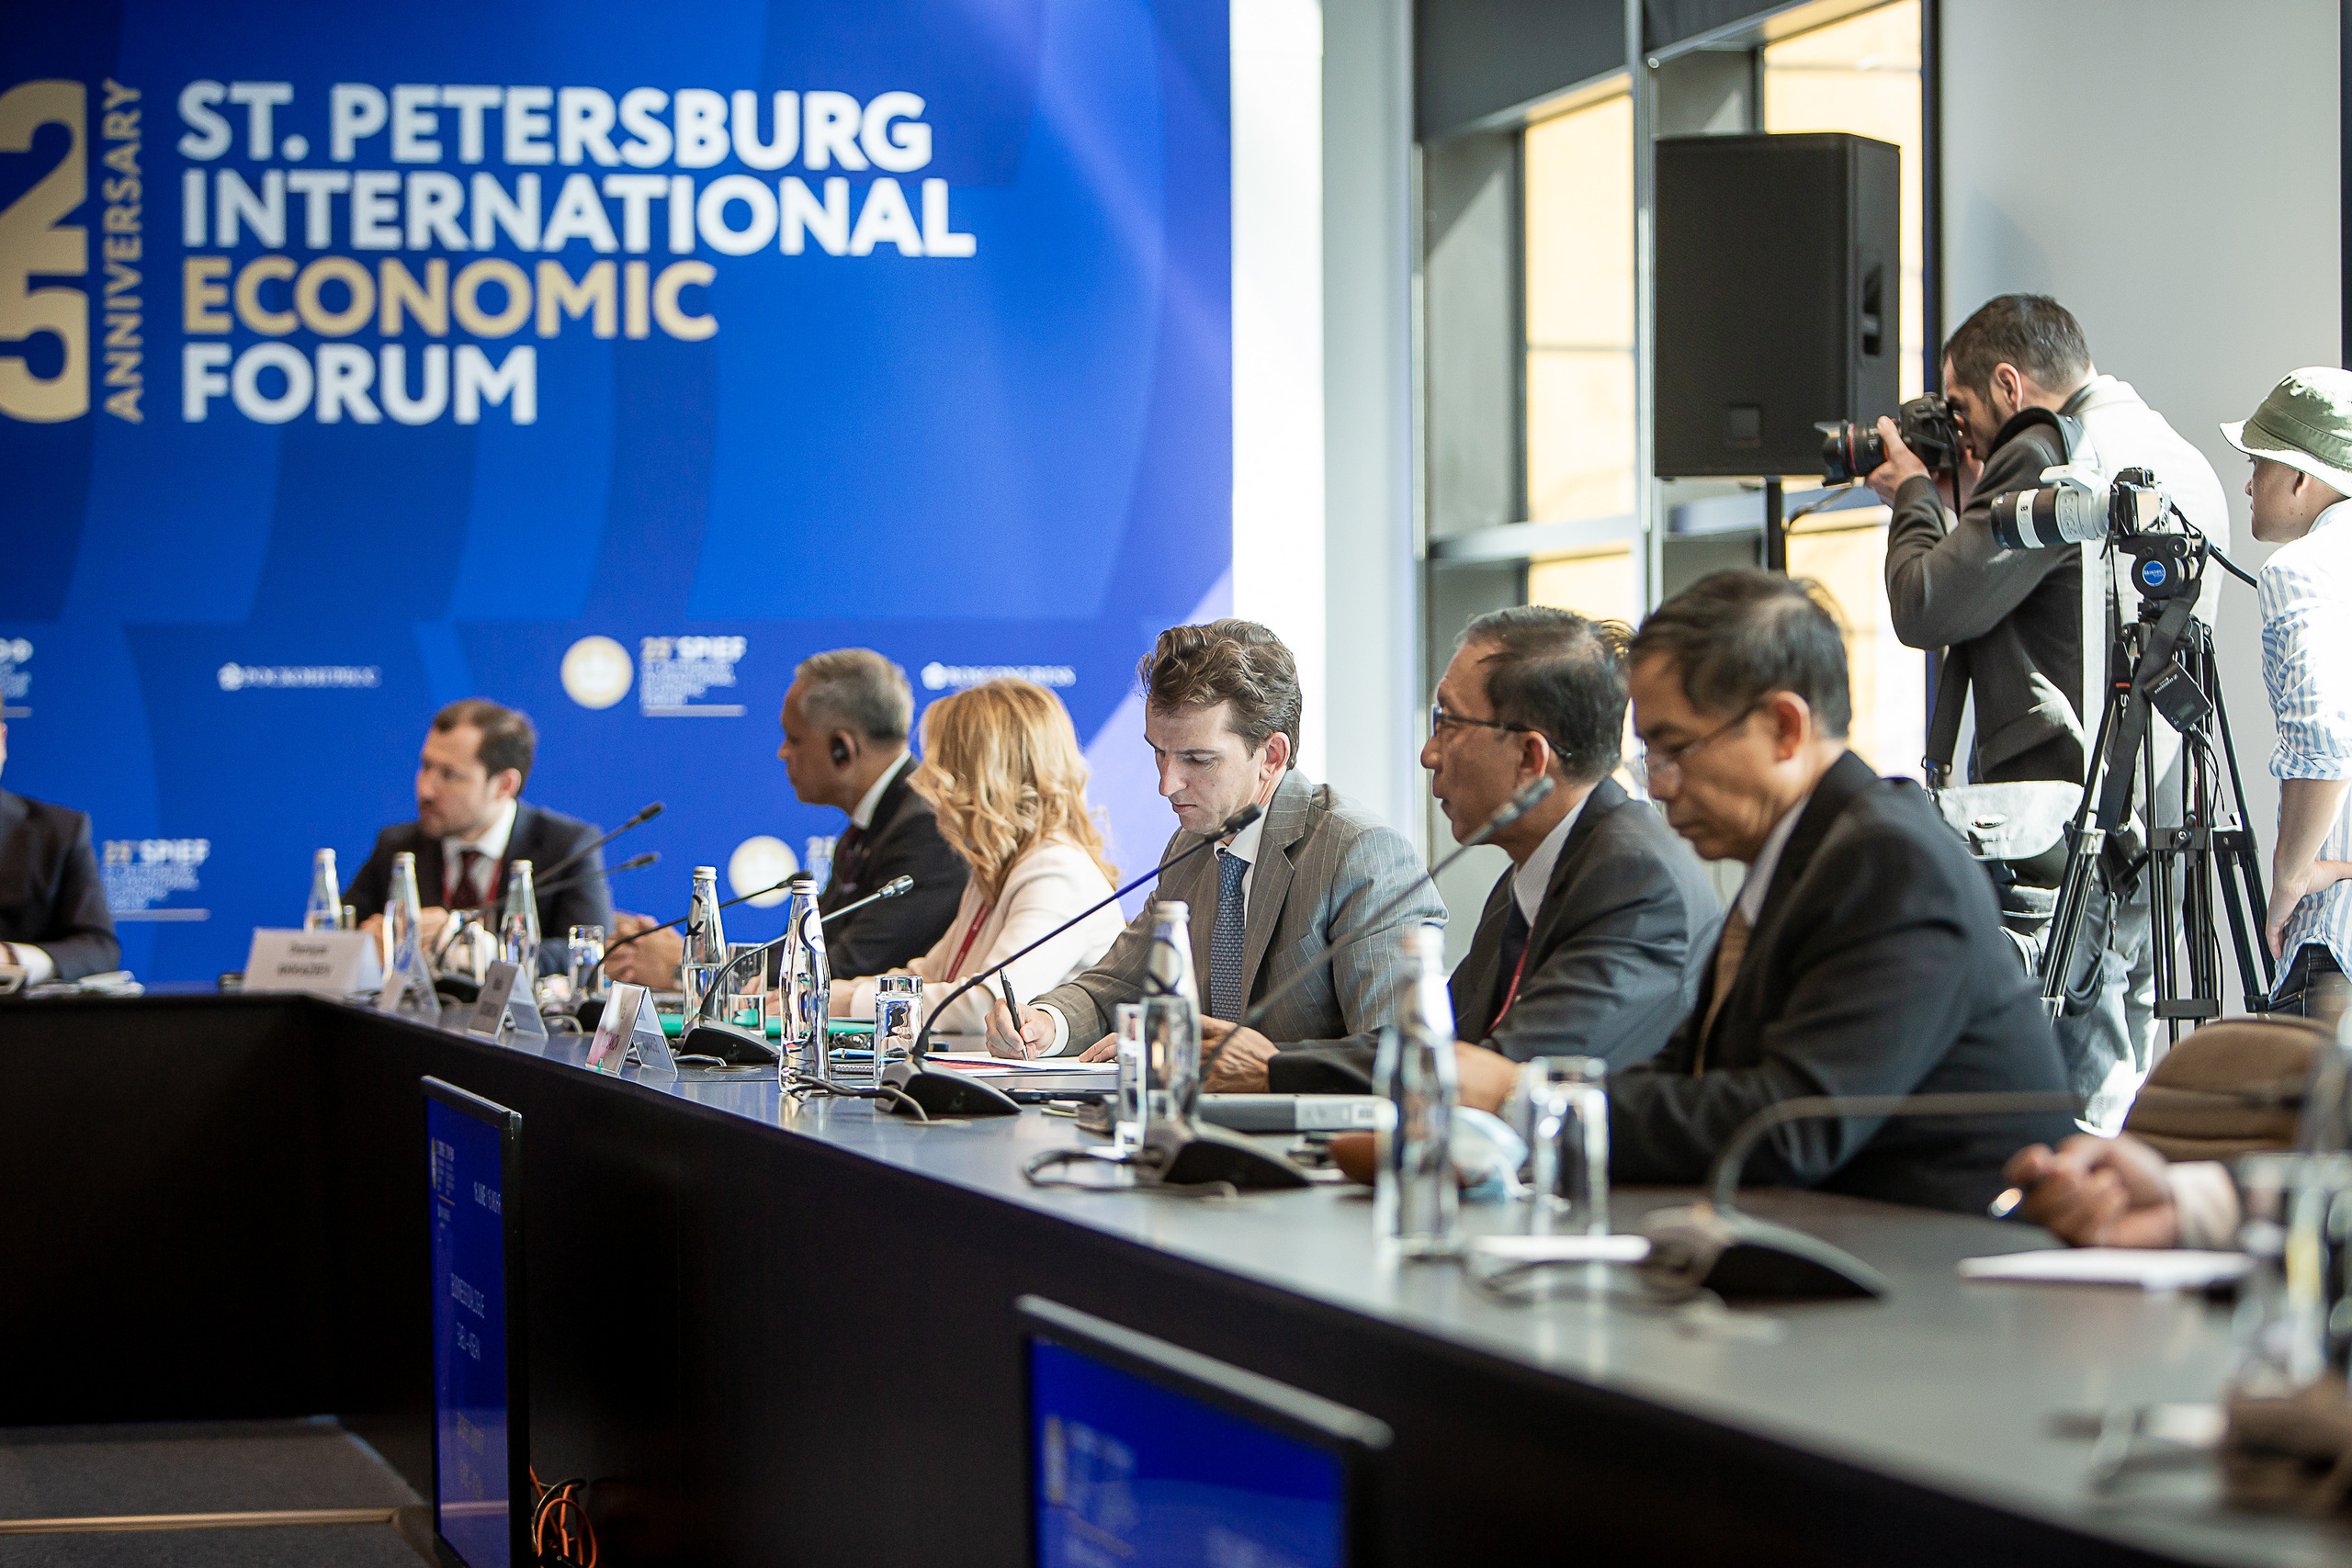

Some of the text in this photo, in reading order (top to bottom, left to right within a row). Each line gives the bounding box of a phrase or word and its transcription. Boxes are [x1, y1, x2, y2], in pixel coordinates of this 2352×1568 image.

[180, 81, 933, 173] ST. PETERSBURG
[102, 77, 144, 424] ANNIVERSARY
[183, 169, 978, 258] INTERNATIONAL
[183, 256, 719, 342] ECONOMIC
[182, 342, 538, 425] FORUM
